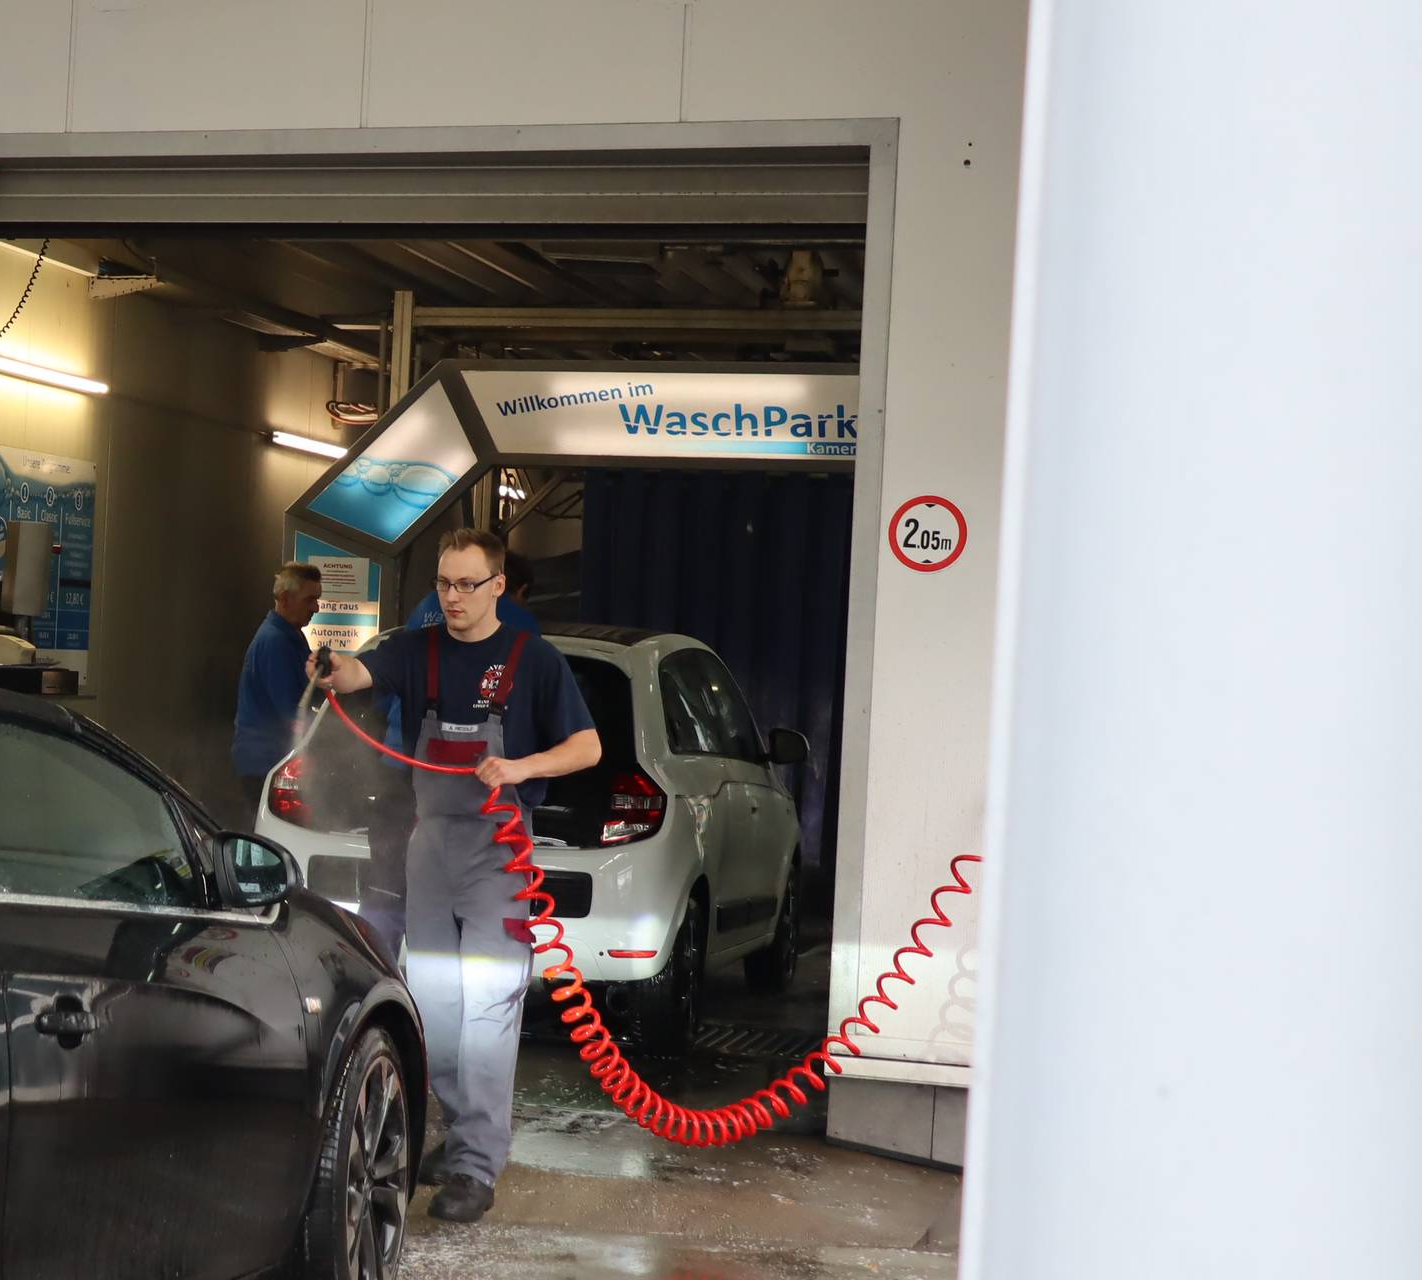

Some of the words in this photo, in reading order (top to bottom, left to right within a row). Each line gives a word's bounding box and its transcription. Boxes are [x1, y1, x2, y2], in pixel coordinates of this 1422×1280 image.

[496, 385, 622, 417] Willkommen
[628, 381, 654, 398] im
[618, 402, 857, 438] WaschPark
[320, 602, 337, 611] ang
[339, 602, 359, 610] raus
[311, 628, 359, 638] Automatik
